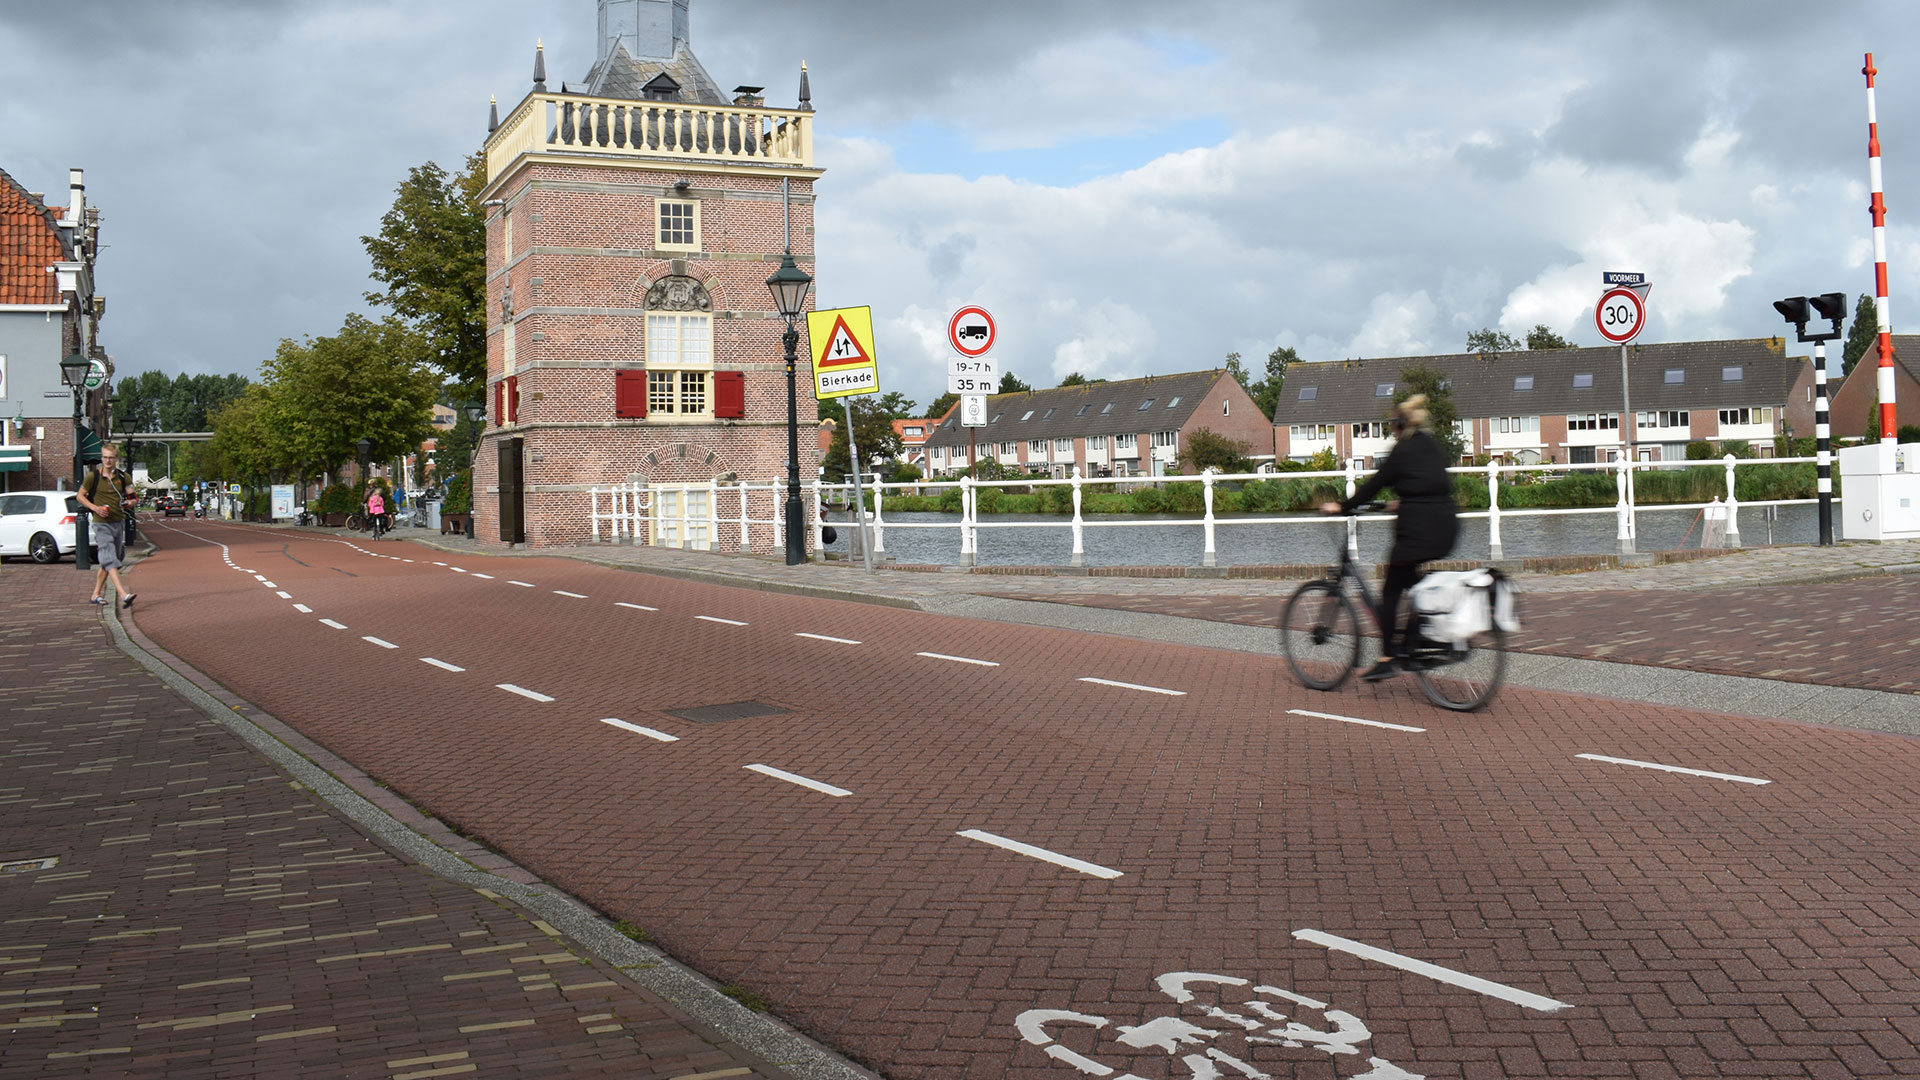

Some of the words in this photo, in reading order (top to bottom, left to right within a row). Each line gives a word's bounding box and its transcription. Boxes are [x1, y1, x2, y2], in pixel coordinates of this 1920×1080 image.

[1609, 274, 1640, 283] VOORMEER
[956, 362, 981, 372] 19-7
[984, 363, 991, 372] h
[821, 373, 872, 387] Bierkade
[957, 379, 974, 390] 35
[979, 382, 991, 390] m
